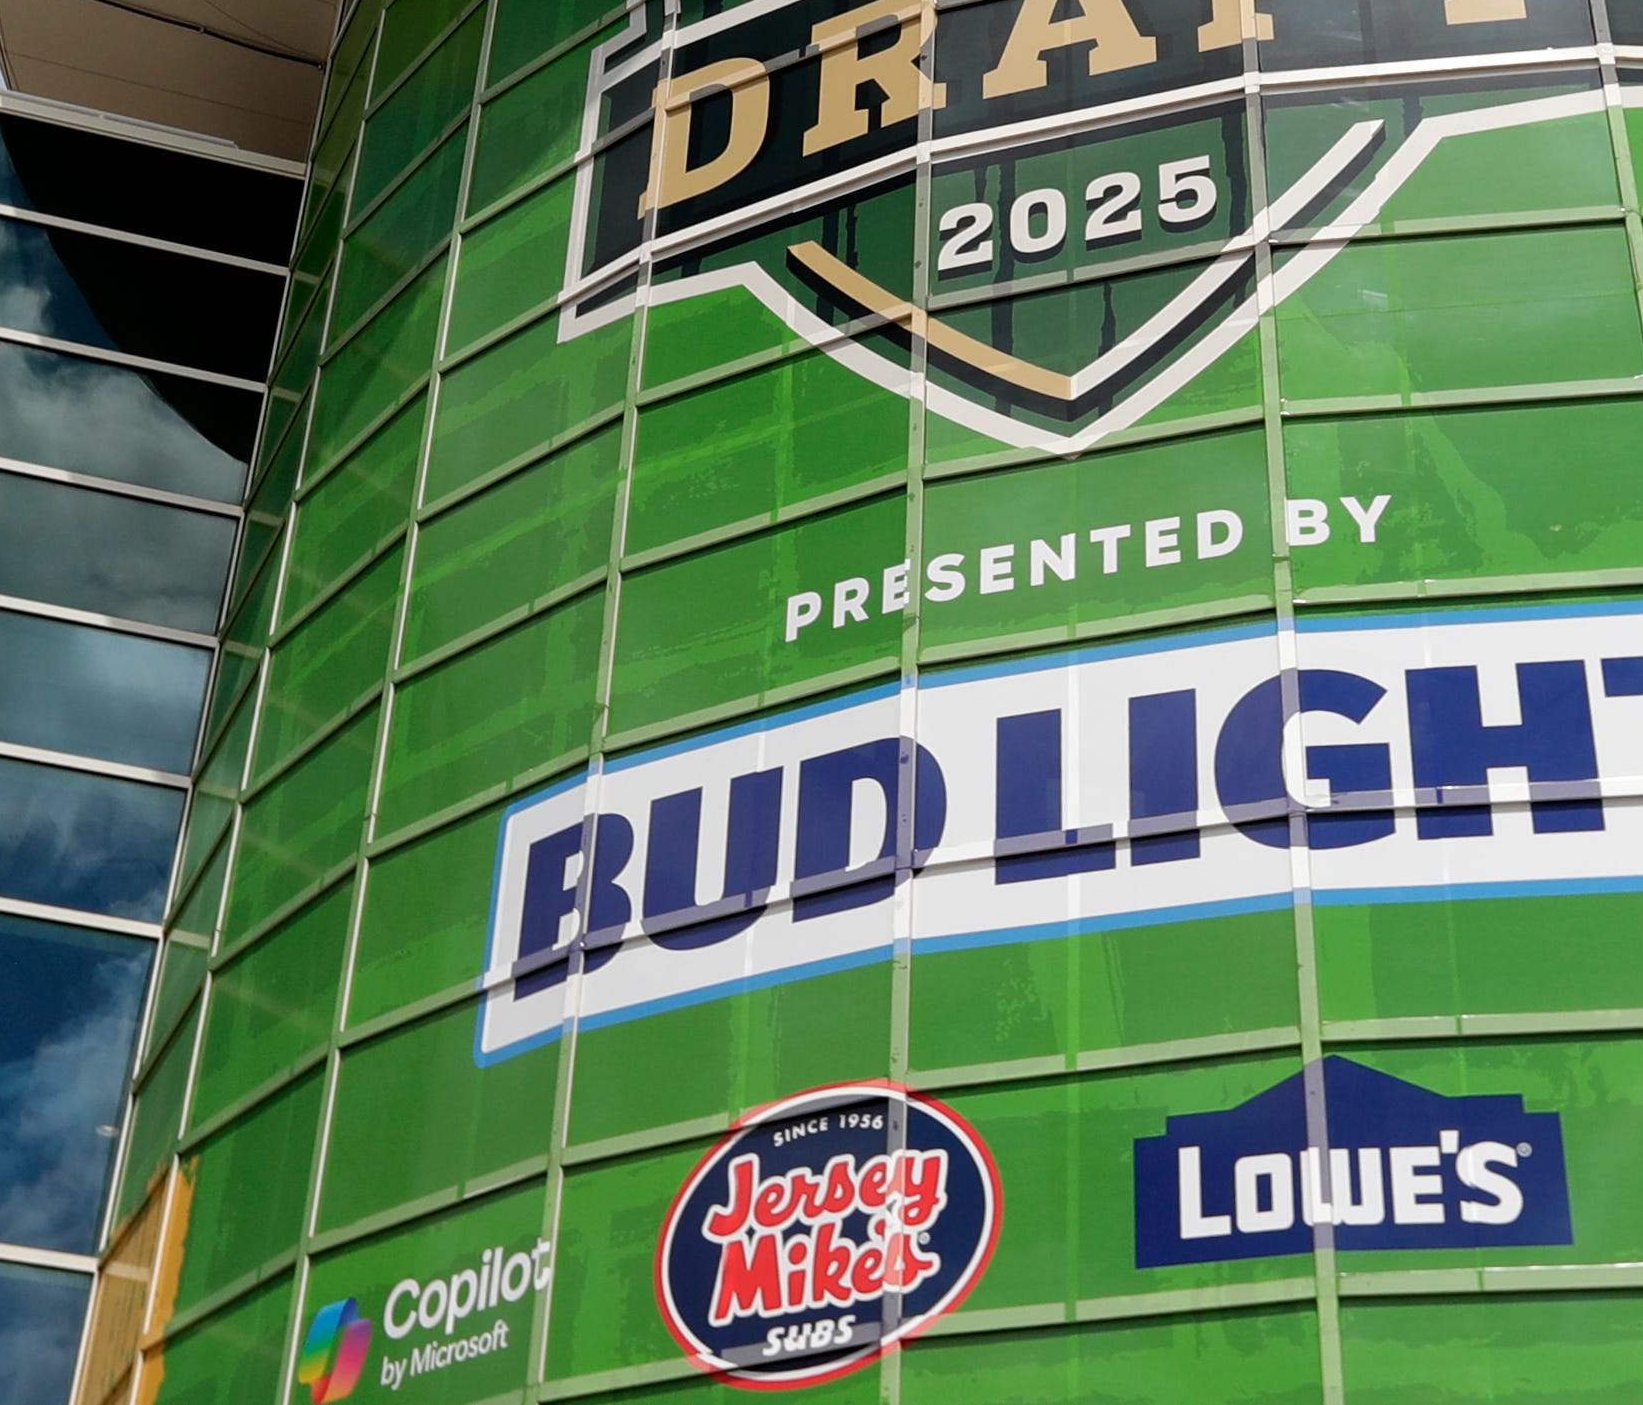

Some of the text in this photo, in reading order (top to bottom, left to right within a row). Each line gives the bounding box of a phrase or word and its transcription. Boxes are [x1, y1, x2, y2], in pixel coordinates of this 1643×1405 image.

[938, 155, 1217, 270] 2025
[784, 494, 1393, 643] PRESENTED BY
[512, 734, 949, 1003] BUD
[773, 1114, 884, 1148] SINCE 1956
[702, 1149, 948, 1241] Jersey
[1178, 1129, 1524, 1240] LOWE'S
[383, 1238, 551, 1340] Copilot
[380, 1319, 509, 1391] by Microsoft
